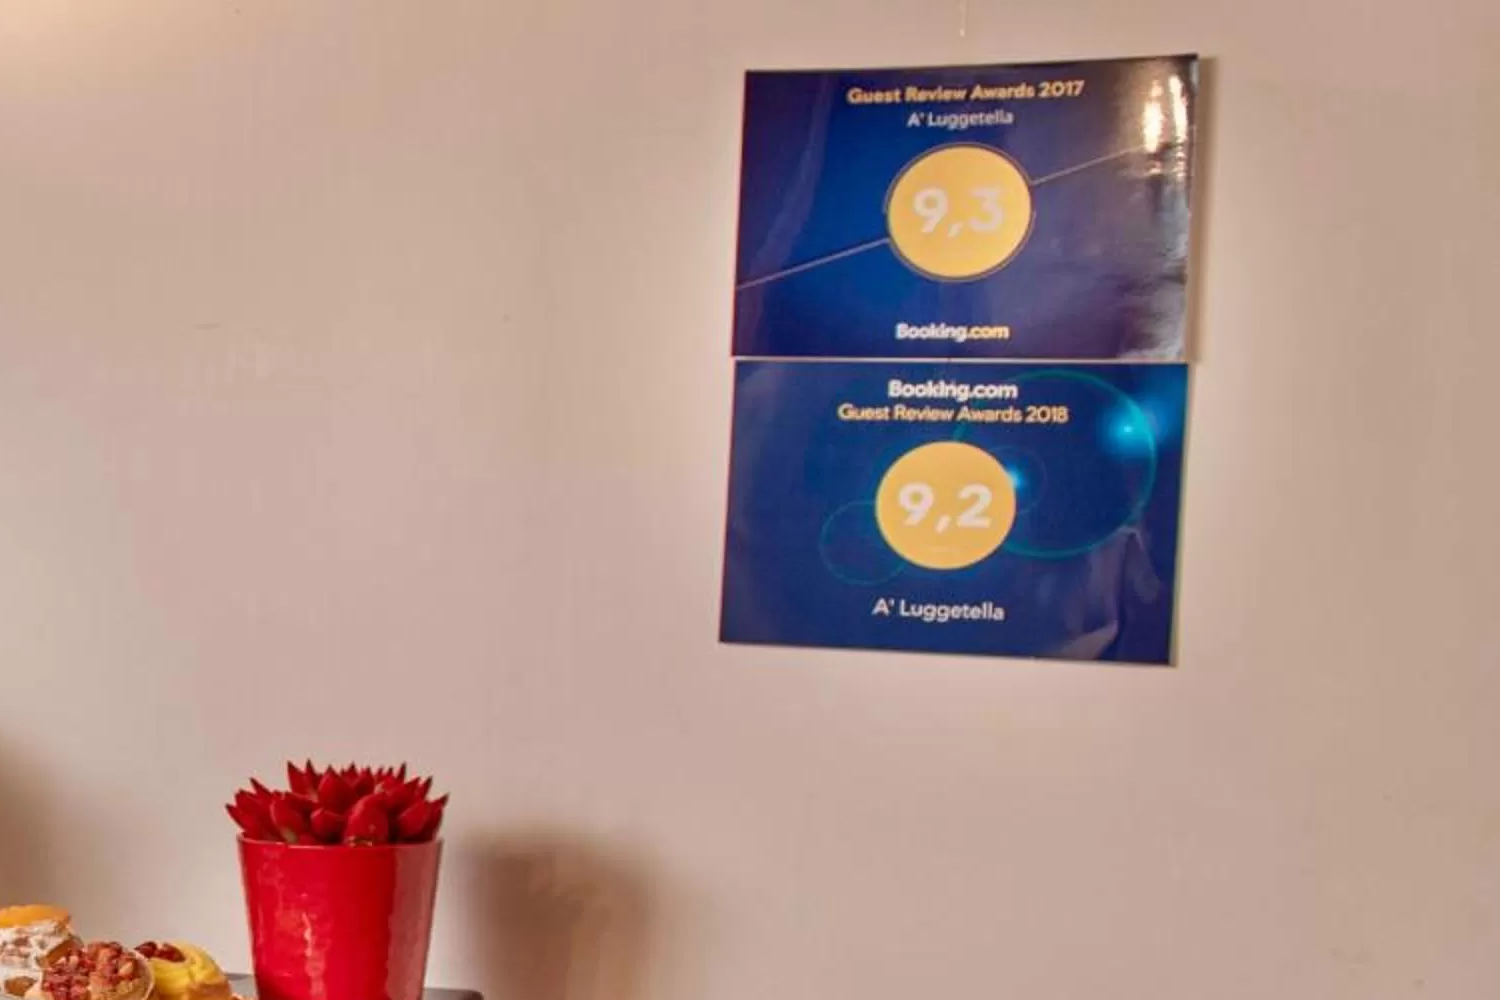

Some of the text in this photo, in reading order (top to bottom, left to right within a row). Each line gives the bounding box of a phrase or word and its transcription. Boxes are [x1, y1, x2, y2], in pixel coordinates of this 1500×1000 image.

[846, 80, 1085, 104] Guest Review Awards 2017
[928, 109, 1014, 130] Luggetella
[912, 186, 1005, 238] 9,3
[895, 322, 1010, 343] Booking.com
[888, 378, 1018, 402] Booking.com
[837, 403, 1069, 424] Guest Review Awards 2018
[898, 482, 993, 535] 9,2
[871, 597, 1005, 623] A' Luggetella
